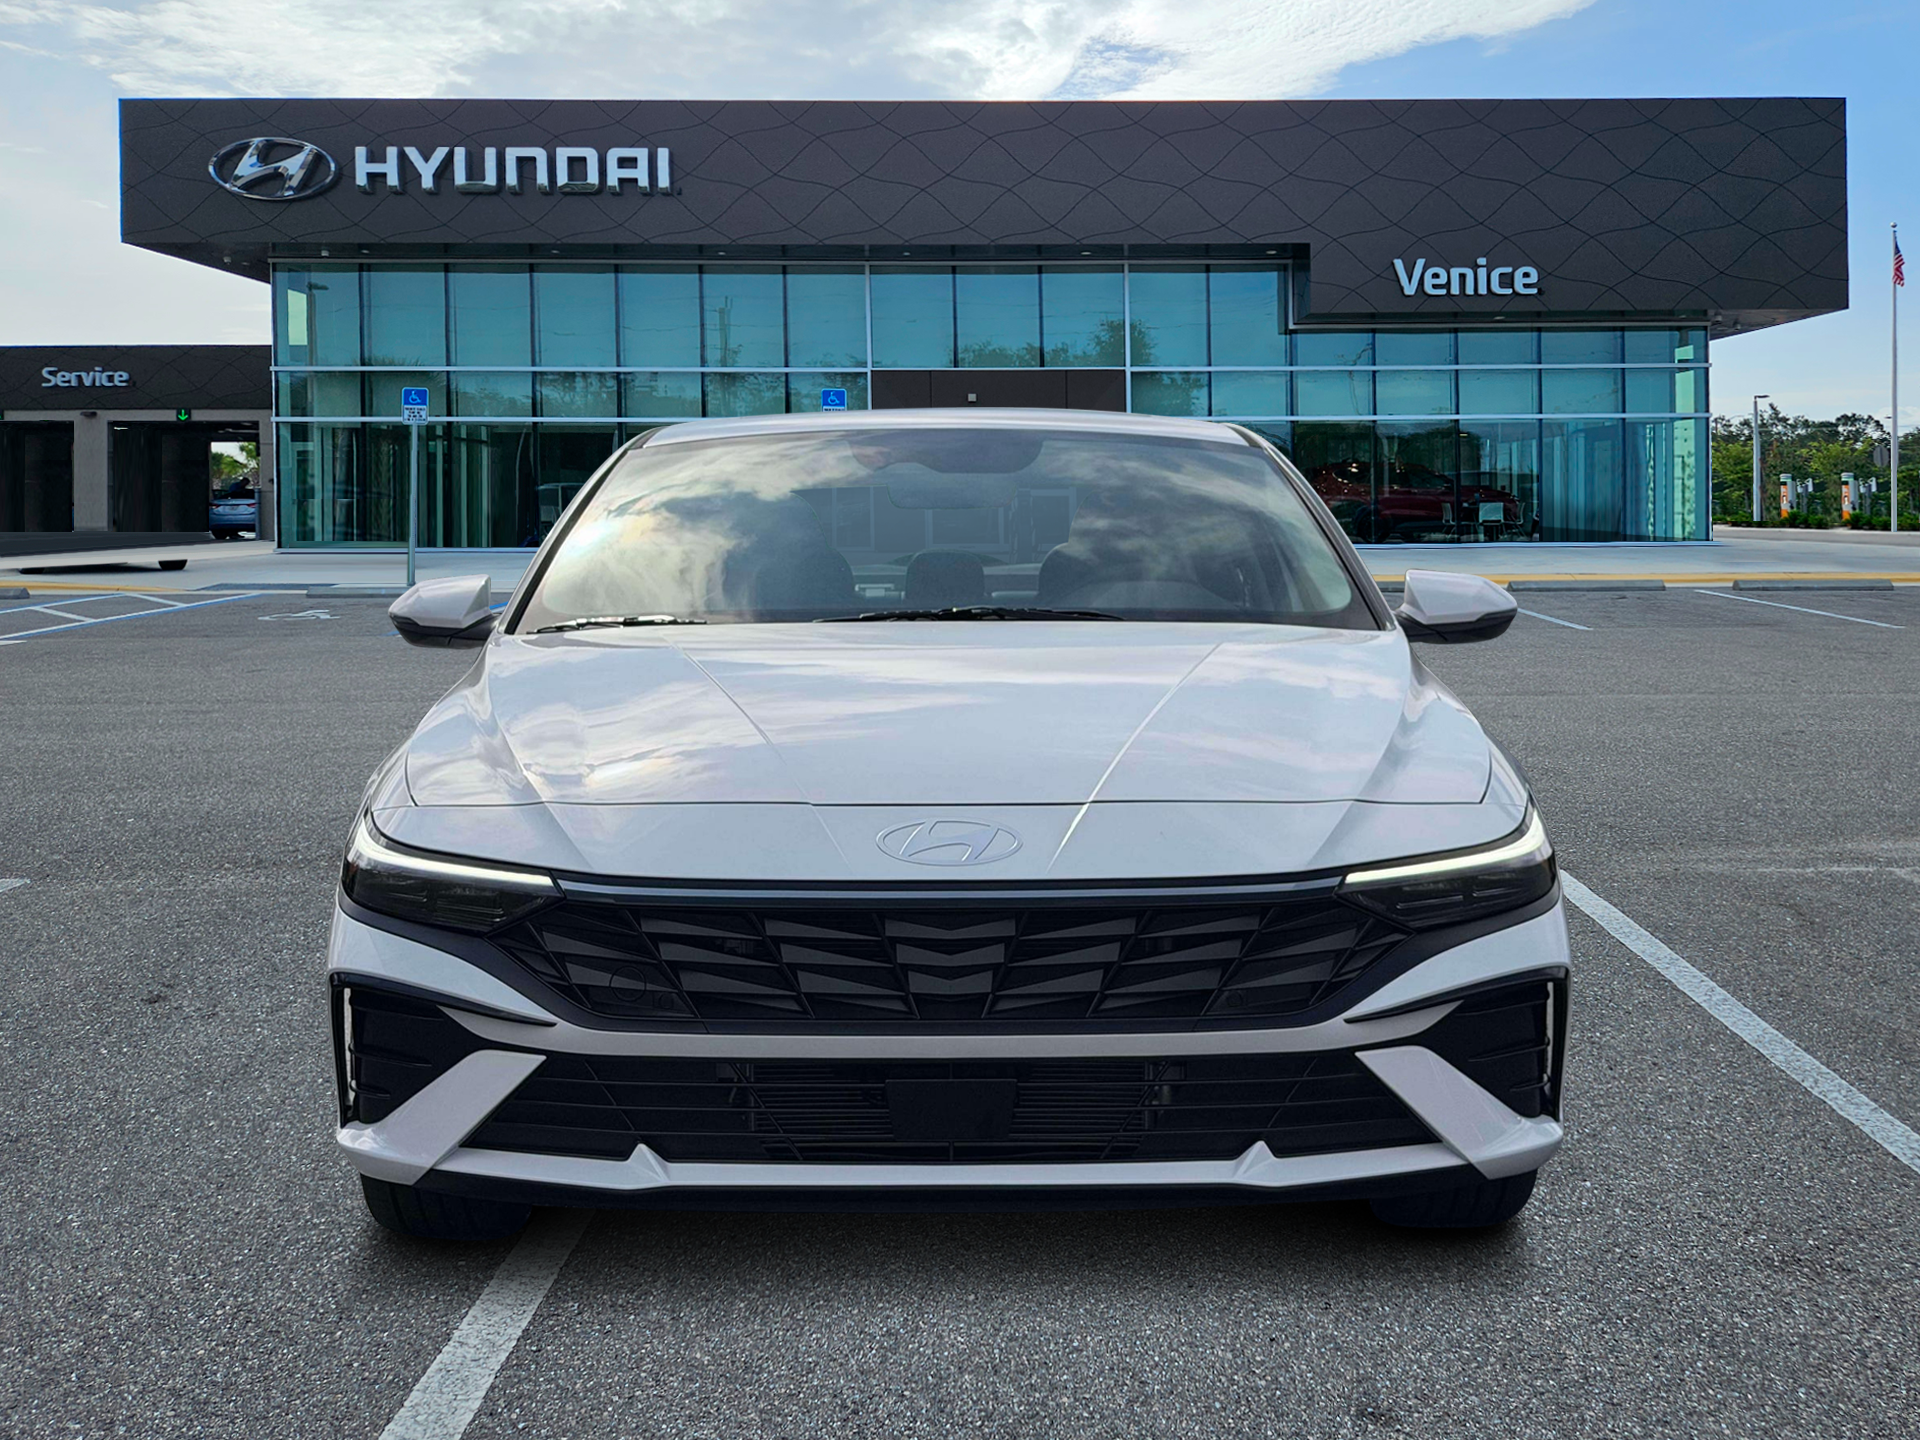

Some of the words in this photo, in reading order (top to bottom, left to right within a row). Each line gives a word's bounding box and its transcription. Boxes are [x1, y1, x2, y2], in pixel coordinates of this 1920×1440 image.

[354, 146, 673, 195] HYUNDAI
[1393, 257, 1539, 296] Venice
[41, 366, 130, 387] Service
